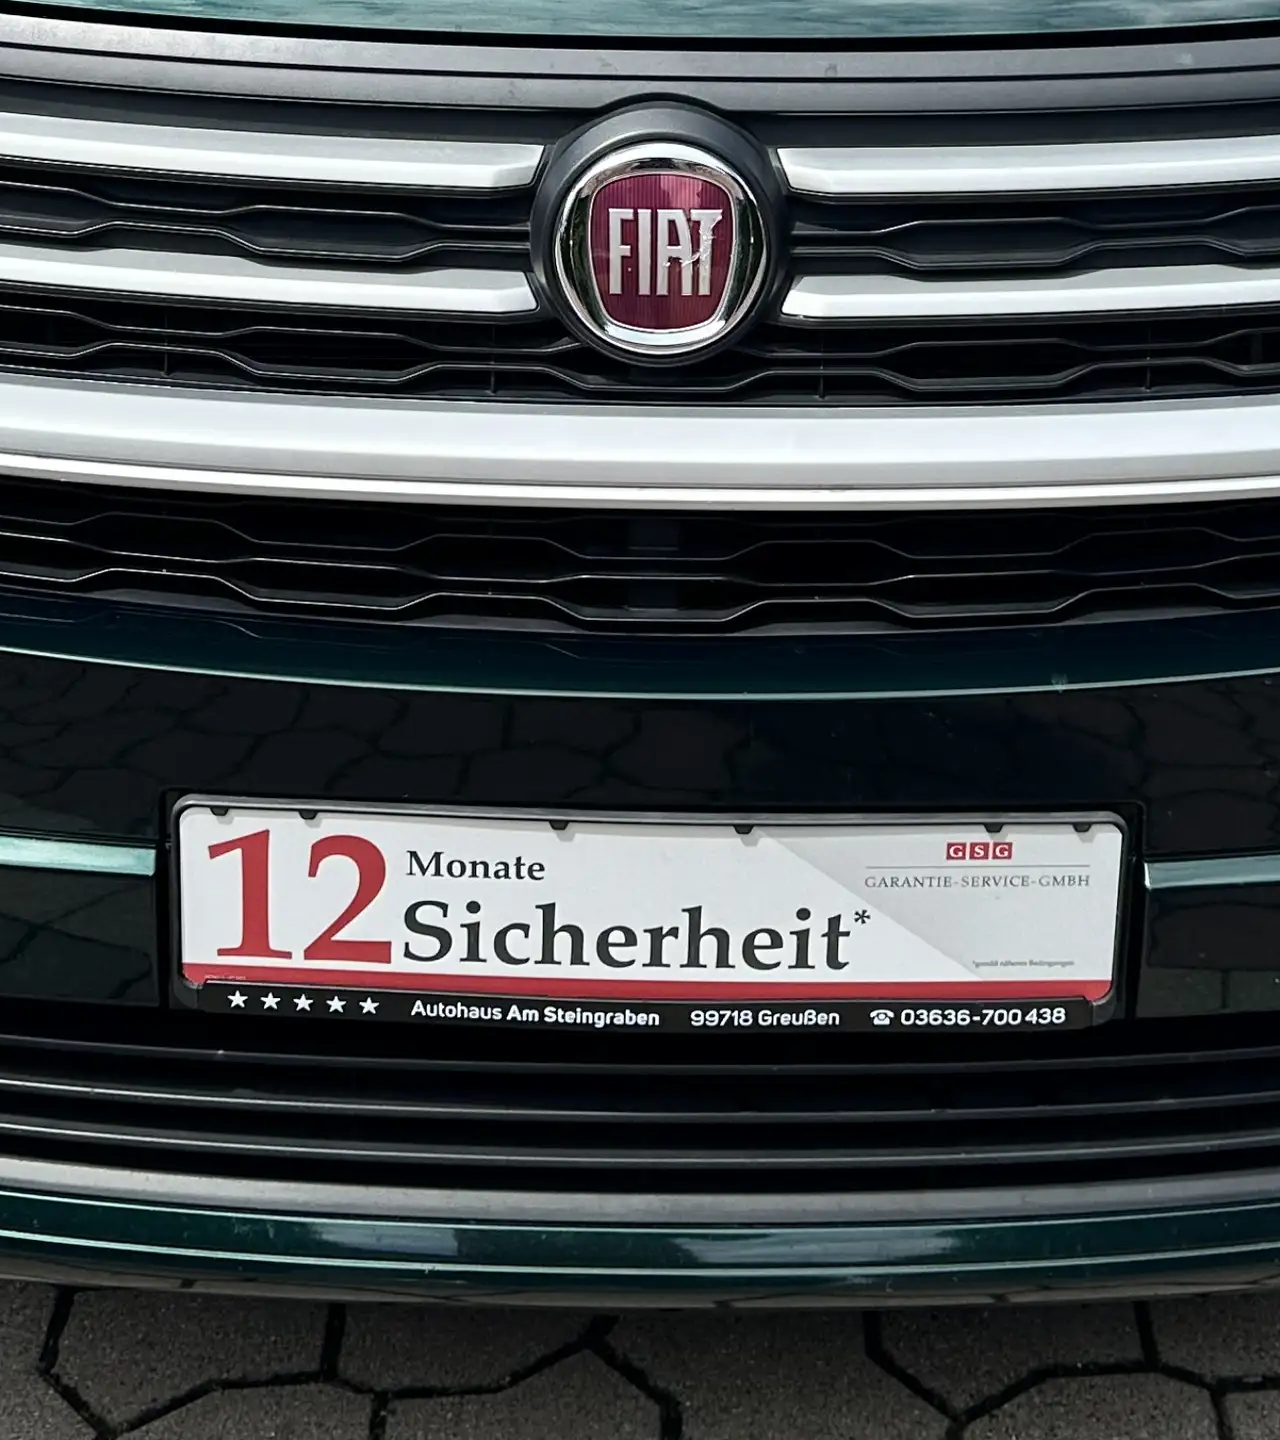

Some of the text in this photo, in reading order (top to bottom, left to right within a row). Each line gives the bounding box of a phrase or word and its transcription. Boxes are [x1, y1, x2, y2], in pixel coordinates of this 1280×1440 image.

[608, 208, 723, 296] FIAT
[946, 842, 1013, 860] GSG
[406, 850, 546, 881] Monate
[864, 874, 1091, 889] GARANTIE-SERVICE-GMBH
[208, 829, 392, 964] 12
[411, 1000, 660, 1028] Autohaus Am Steingraben
[690, 1010, 840, 1027] 99718 Greußen
